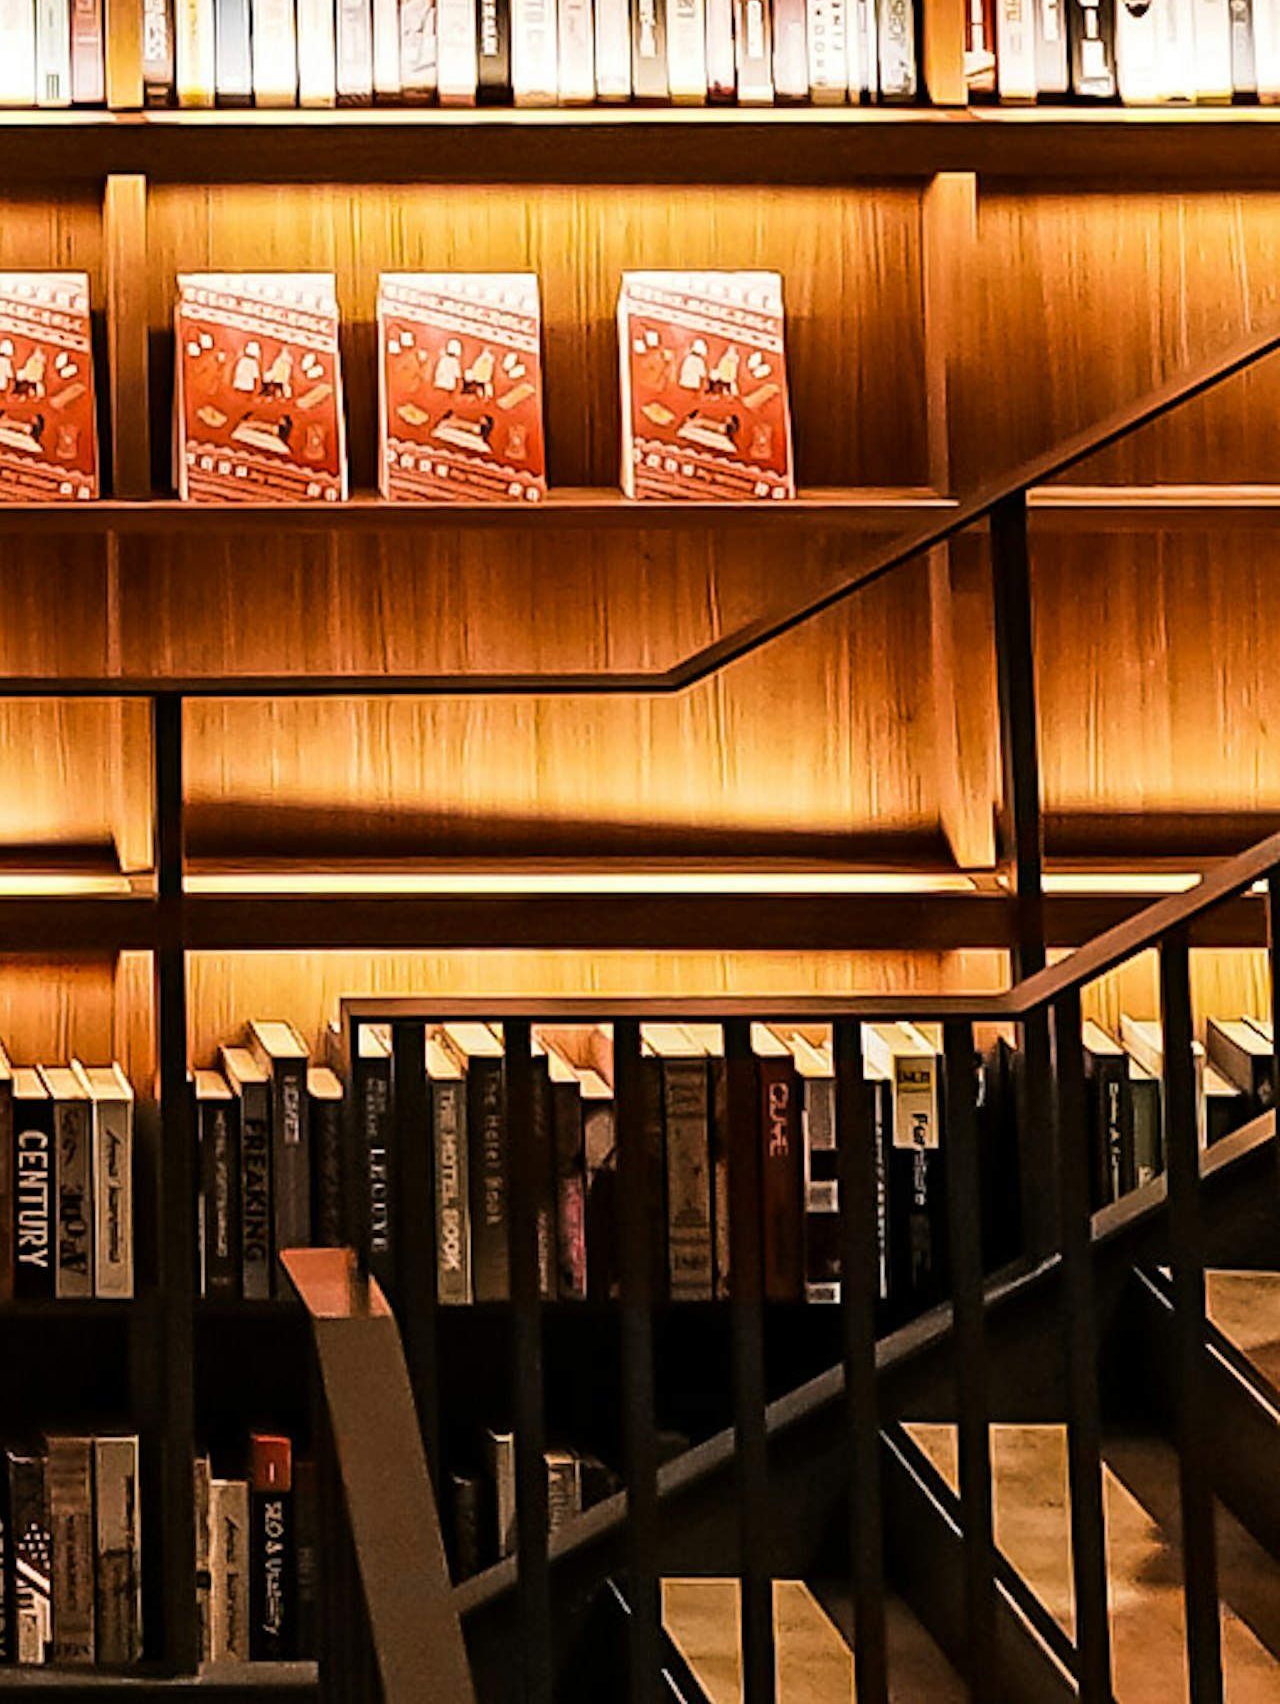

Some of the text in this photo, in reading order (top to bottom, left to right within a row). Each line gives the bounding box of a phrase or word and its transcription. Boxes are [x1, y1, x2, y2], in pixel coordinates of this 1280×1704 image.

[484, 1071, 501, 1101] The
[17, 1131, 48, 1267] CENTURY
[243, 1117, 265, 1262] FREAKING
[438, 1089, 461, 1271] THE HOTEL BOOK
[485, 1178, 503, 1225] Book
[911, 1112, 930, 1205] Furniture
[263, 1502, 283, 1536] SEO
